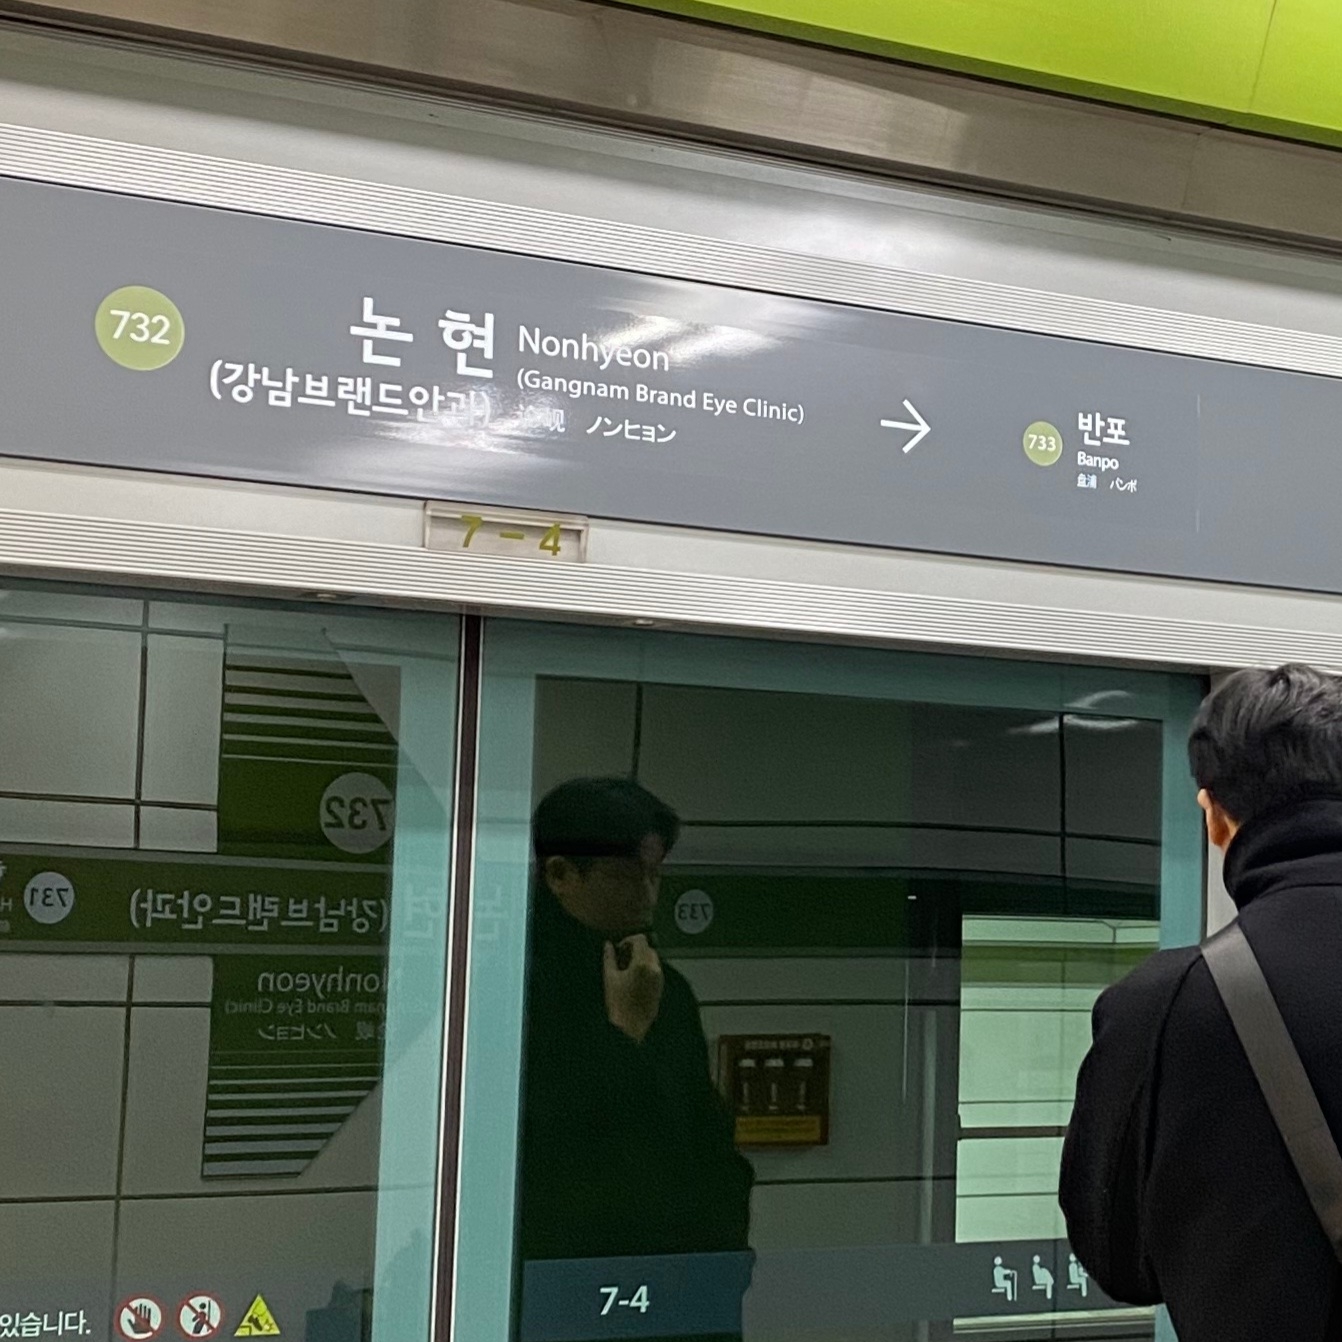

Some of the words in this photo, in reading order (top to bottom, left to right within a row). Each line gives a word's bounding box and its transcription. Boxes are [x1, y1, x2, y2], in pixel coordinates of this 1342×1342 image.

[109, 310, 171, 345] 732
[517, 324, 670, 372] Nonhyeon
[517, 367, 630, 402] (Gangnam
[635, 382, 697, 409] Brand
[702, 391, 738, 421] Eye
[742, 396, 805, 427] Clinic)
[586, 415, 677, 444] ノンヒョン
[1028, 434, 1057, 452] 733
[1078, 412, 1131, 446] 반포
[1077, 450, 1120, 471] Banpo
[599, 1285, 650, 1315] 7-4
[0, 1310, 92, 1338] 있습니다.
